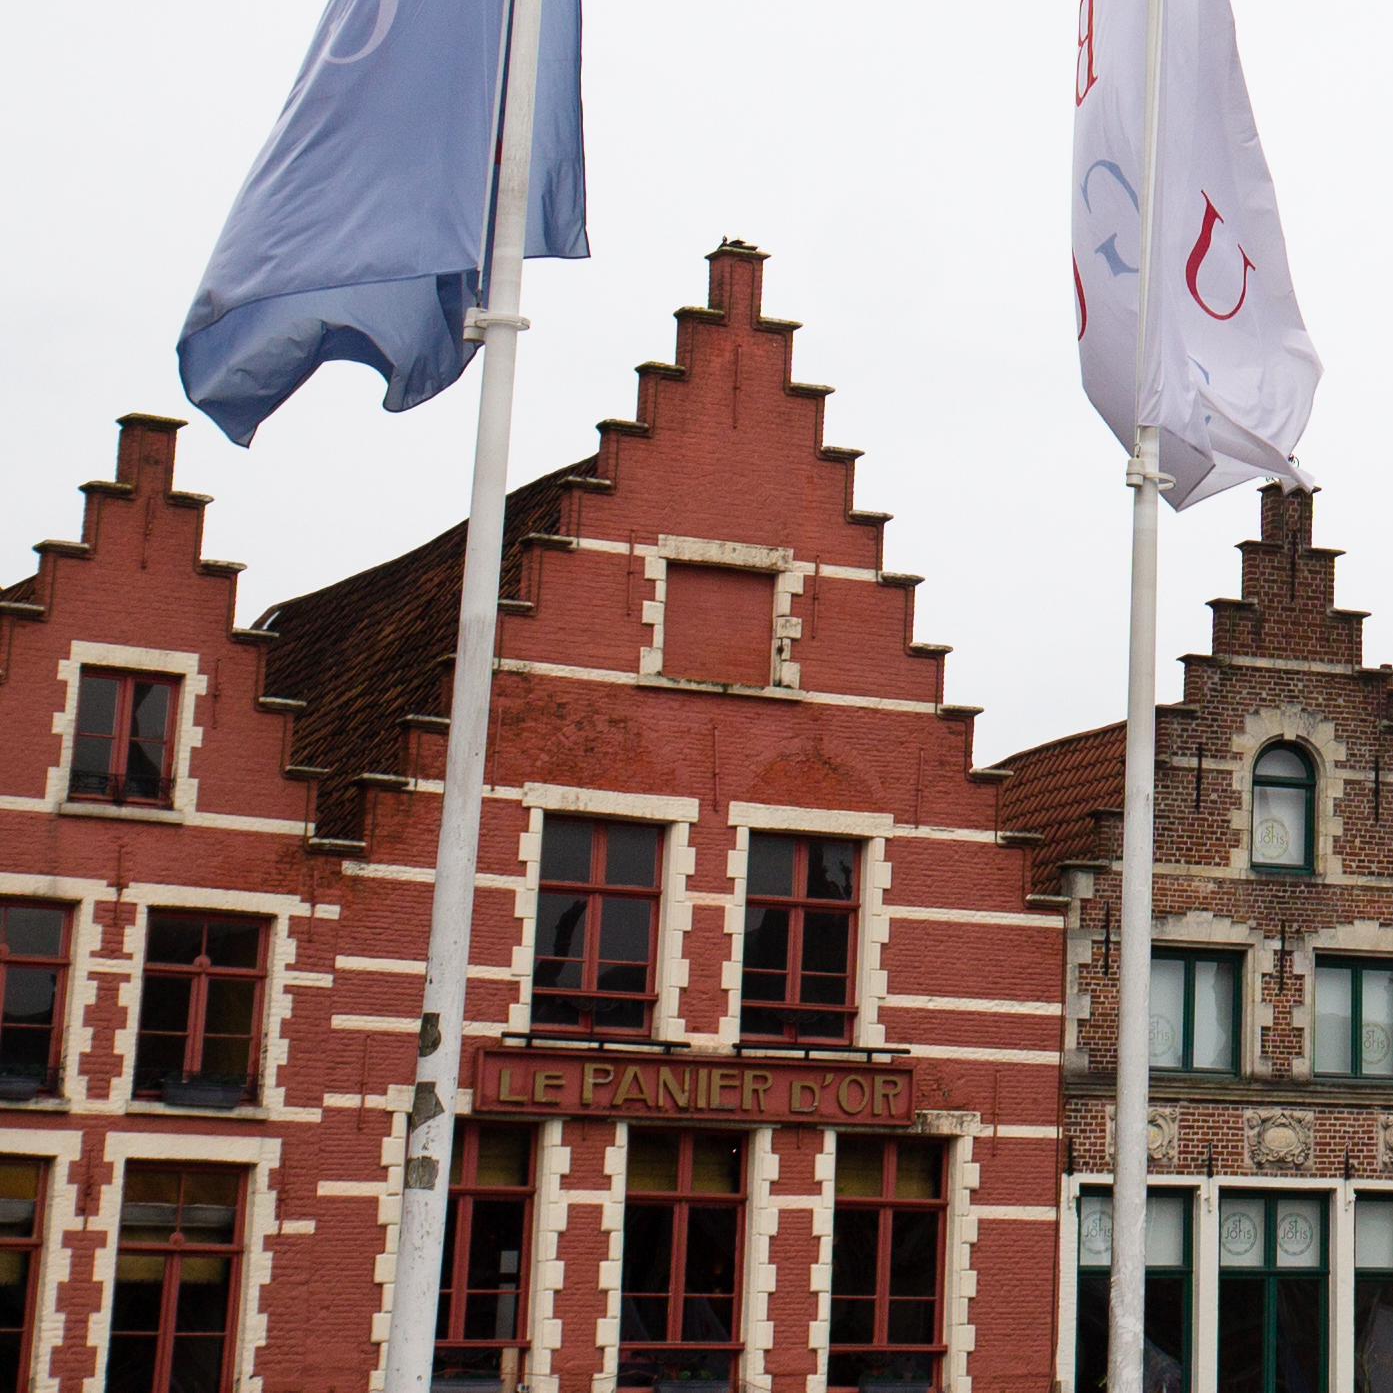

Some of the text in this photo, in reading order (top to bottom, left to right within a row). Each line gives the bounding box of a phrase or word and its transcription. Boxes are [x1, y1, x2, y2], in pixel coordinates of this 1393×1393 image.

[1150, 1030, 1170, 1042] oris
[1363, 1037, 1386, 1050] oris
[499, 1068, 565, 1105] LE
[581, 1062, 773, 1112] PANIER
